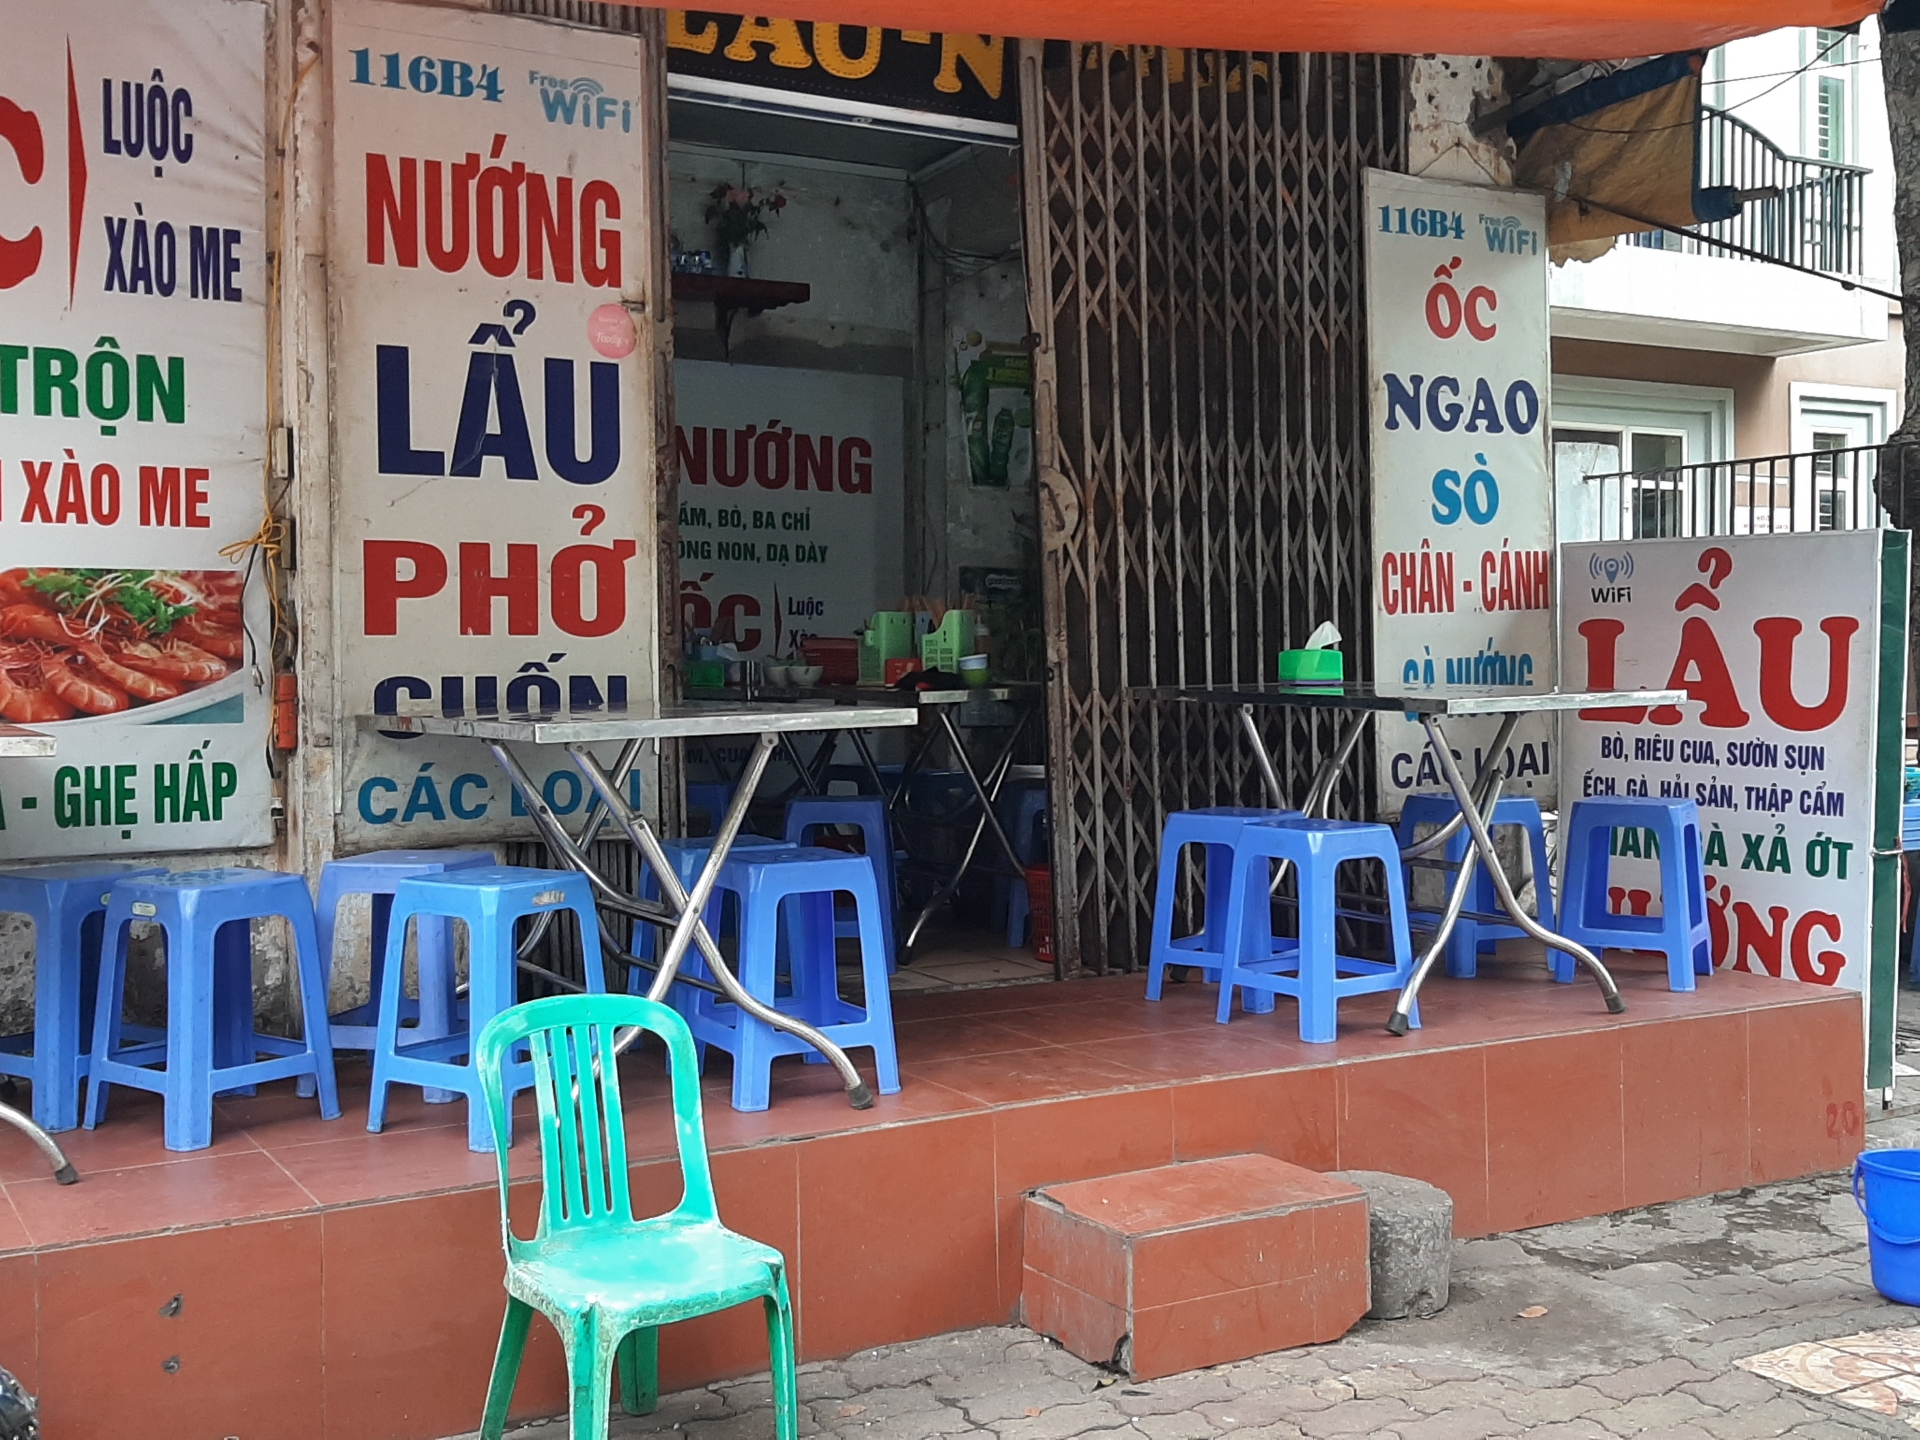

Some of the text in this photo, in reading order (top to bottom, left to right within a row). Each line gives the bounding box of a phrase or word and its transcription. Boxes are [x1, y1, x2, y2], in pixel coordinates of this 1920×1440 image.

[349, 48, 505, 102] 116B4
[102, 69, 194, 178] LUỘC
[540, 88, 631, 133] WiFi
[366, 133, 622, 288] NƯỚNG
[1378, 205, 1465, 240] 116B4
[1485, 226, 1537, 256] WiFi
[104, 202, 243, 302] XÀO ME
[1425, 256, 1497, 342] ỐC
[0, 336, 185, 437] TRỘN
[376, 299, 621, 486] LẨU
[1382, 373, 1539, 435] NGAO
[675, 419, 873, 494] NƯỚNG
[20, 449, 121, 526] XÀO
[139, 466, 211, 528] ME
[718, 505, 747, 531] BÒ,
[753, 511, 777, 530] BA
[1432, 452, 1500, 525] SÒ
[363, 504, 637, 638] PHỞ
[718, 542, 761, 564] NON,
[767, 543, 790, 566] DẠ
[796, 541, 829, 564] DÀY
[1382, 538, 1454, 615] CHÂN
[1481, 537, 1550, 612] CÁNH
[788, 596, 824, 620] Luộc
[1591, 586, 1632, 603] WiFi
[1578, 547, 1860, 732] LẨU
[1601, 731, 1826, 776] BÒ, RIÊU CUA, SƯỜN SỤN
[54, 766, 137, 840] GHẸ
[154, 739, 238, 824] HẤP
[358, 762, 489, 825] CÁC
[1583, 767, 1616, 797] ẾCH
[1660, 773, 1690, 799] HẢI
[1695, 775, 1738, 812] SẢN,
[1744, 782, 1793, 818] THẬP
[1799, 781, 1845, 818] CẨM
[1741, 823, 1792, 875] XẢ
[1806, 831, 1854, 881] ỚT
[1826, 1101, 1860, 1140] 20
